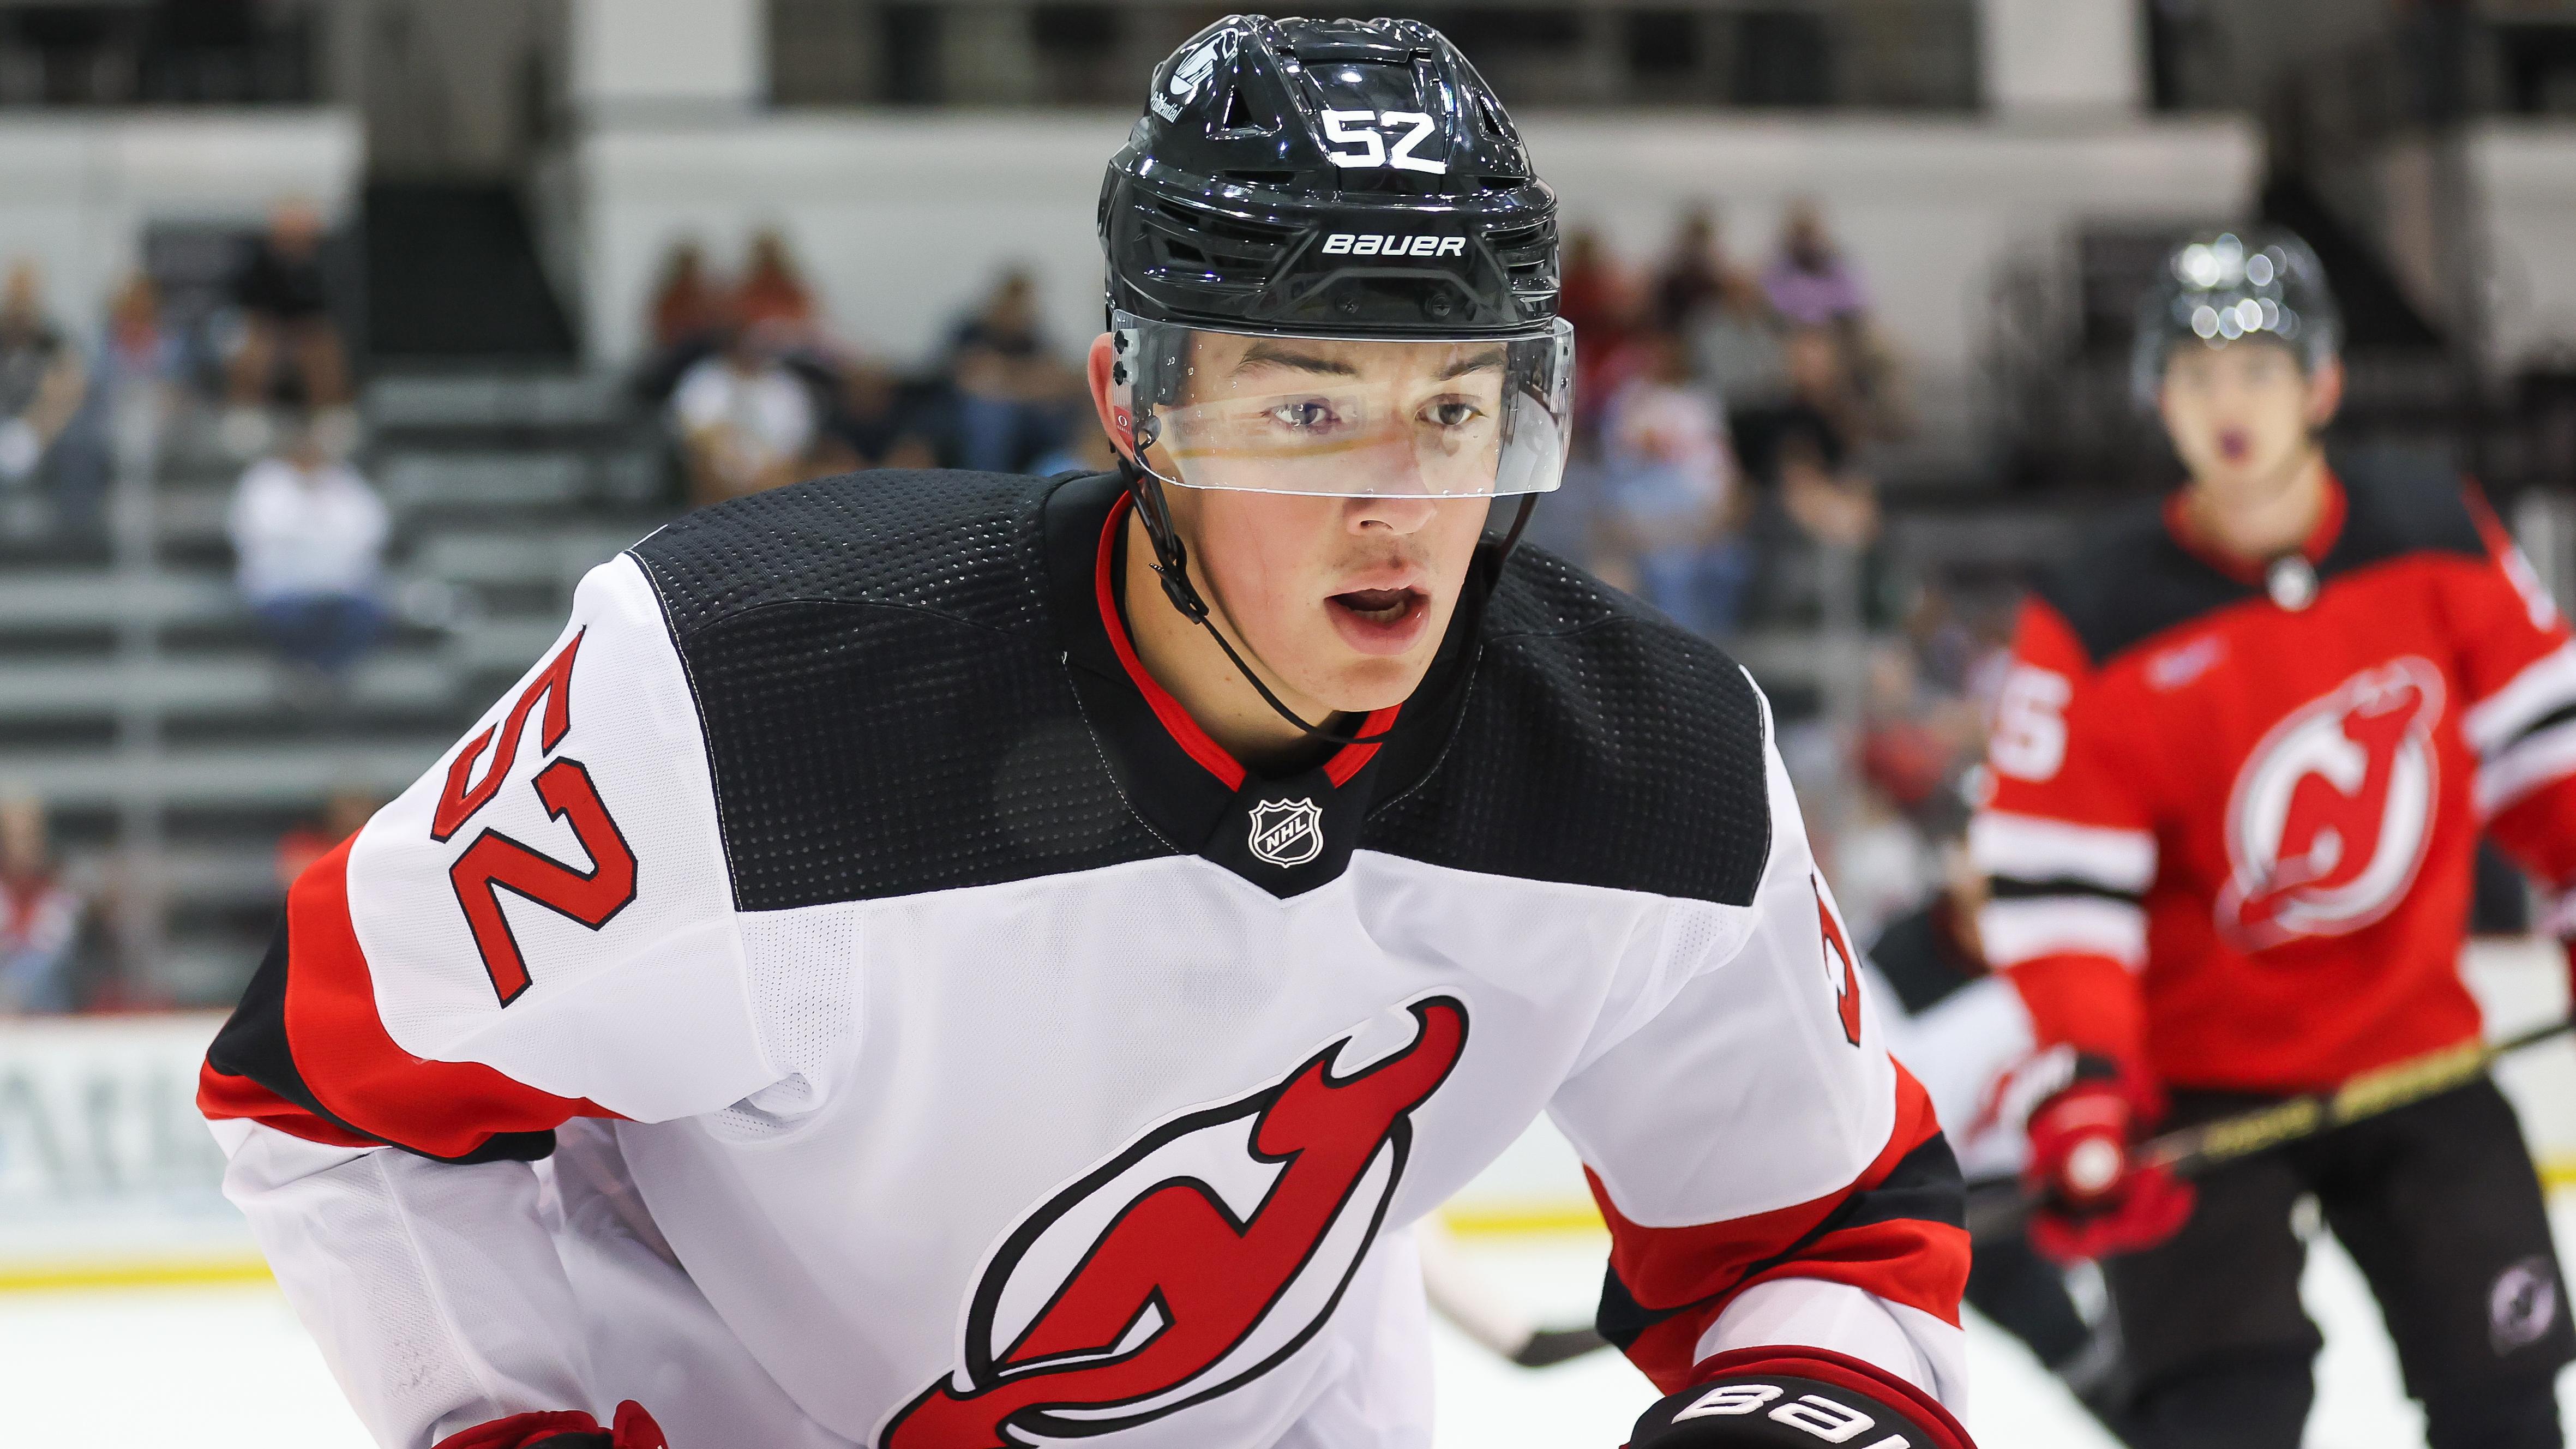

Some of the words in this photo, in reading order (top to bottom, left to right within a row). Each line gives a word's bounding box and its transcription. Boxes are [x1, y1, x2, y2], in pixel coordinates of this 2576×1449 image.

[1321, 110, 1446, 175] 52
[430, 624, 638, 1008] 52
[1266, 817, 1307, 852] NHL
